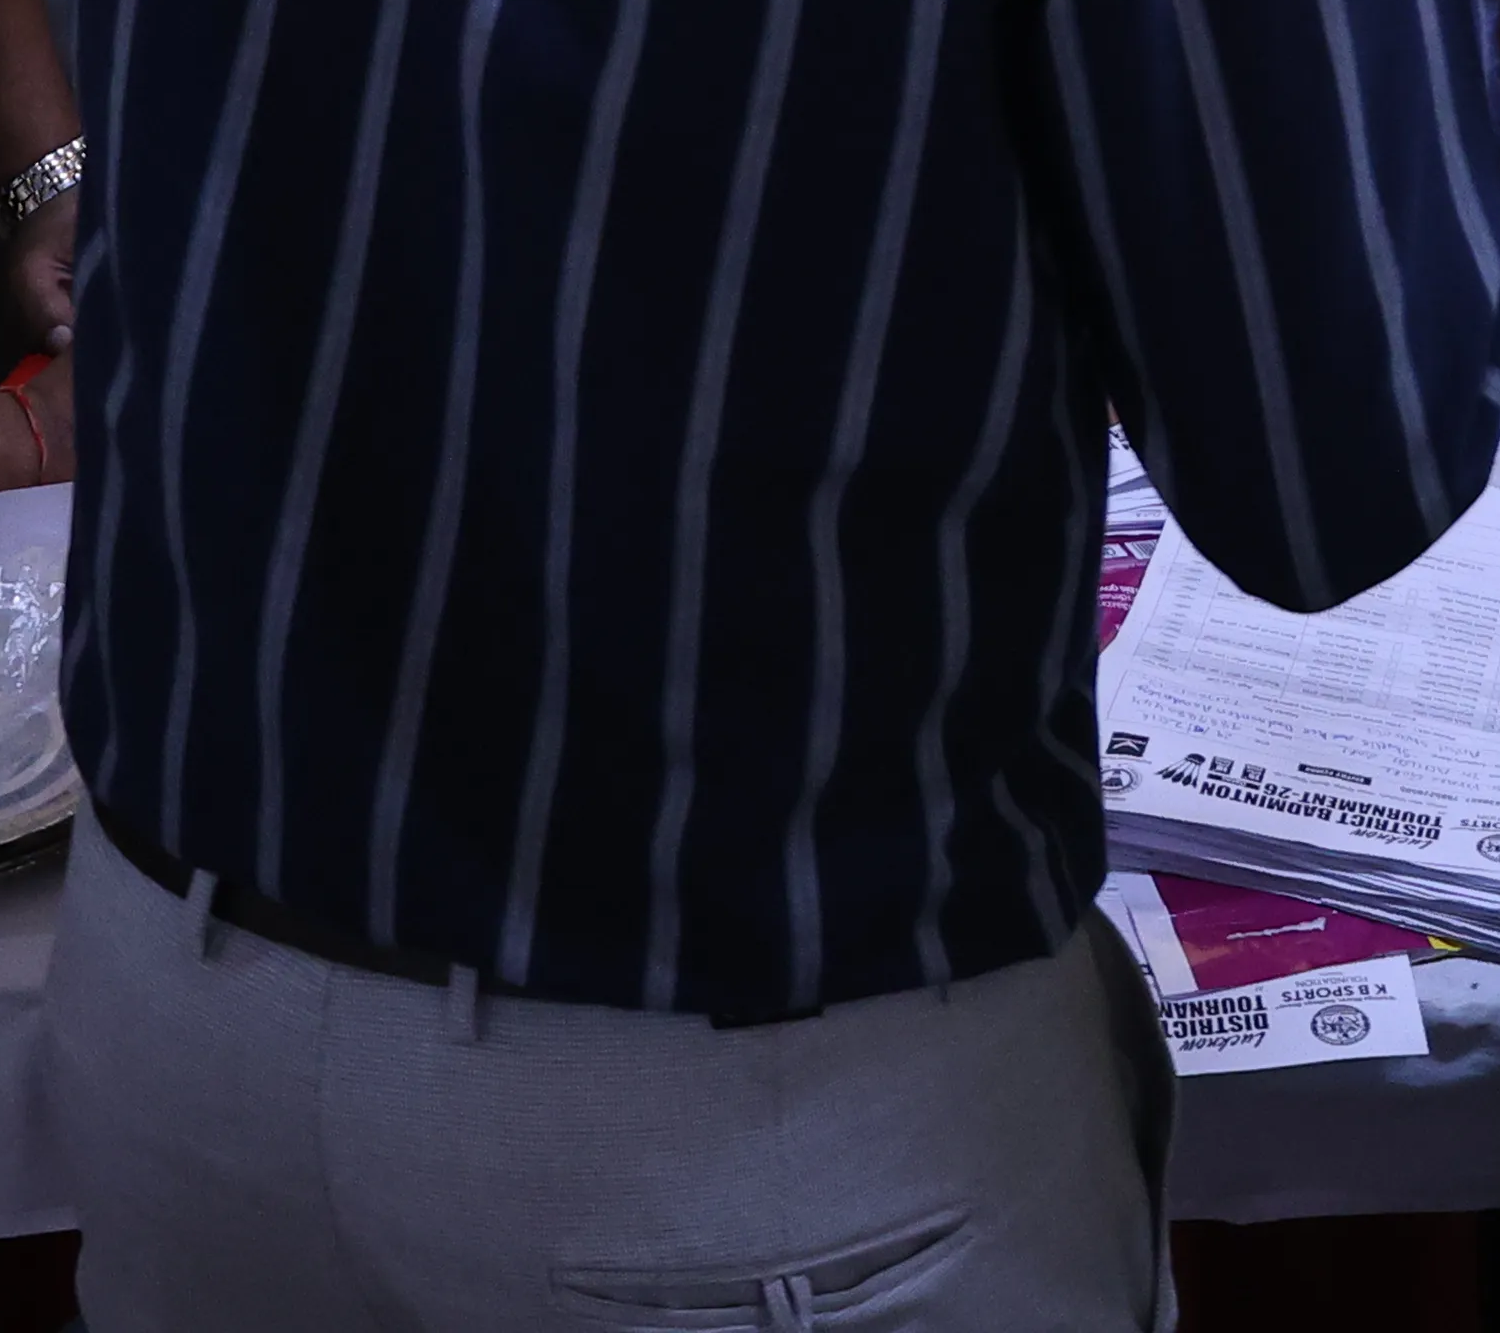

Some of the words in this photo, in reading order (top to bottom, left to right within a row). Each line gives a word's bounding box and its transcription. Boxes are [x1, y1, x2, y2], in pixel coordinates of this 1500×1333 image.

[1200, 781, 1332, 822] BADMINTON
[1263, 783, 1444, 829] TOURNAMENT-26
[1336, 815, 1442, 841] DISTRICT
[1348, 828, 1433, 850] Lucknow
[1281, 985, 1356, 1003] SPORTS
[1358, 984, 1370, 996] B
[1373, 983, 1388, 995] K
[1160, 995, 1268, 1019] TOURNAM
[1178, 1032, 1266, 1053] Lucknow
